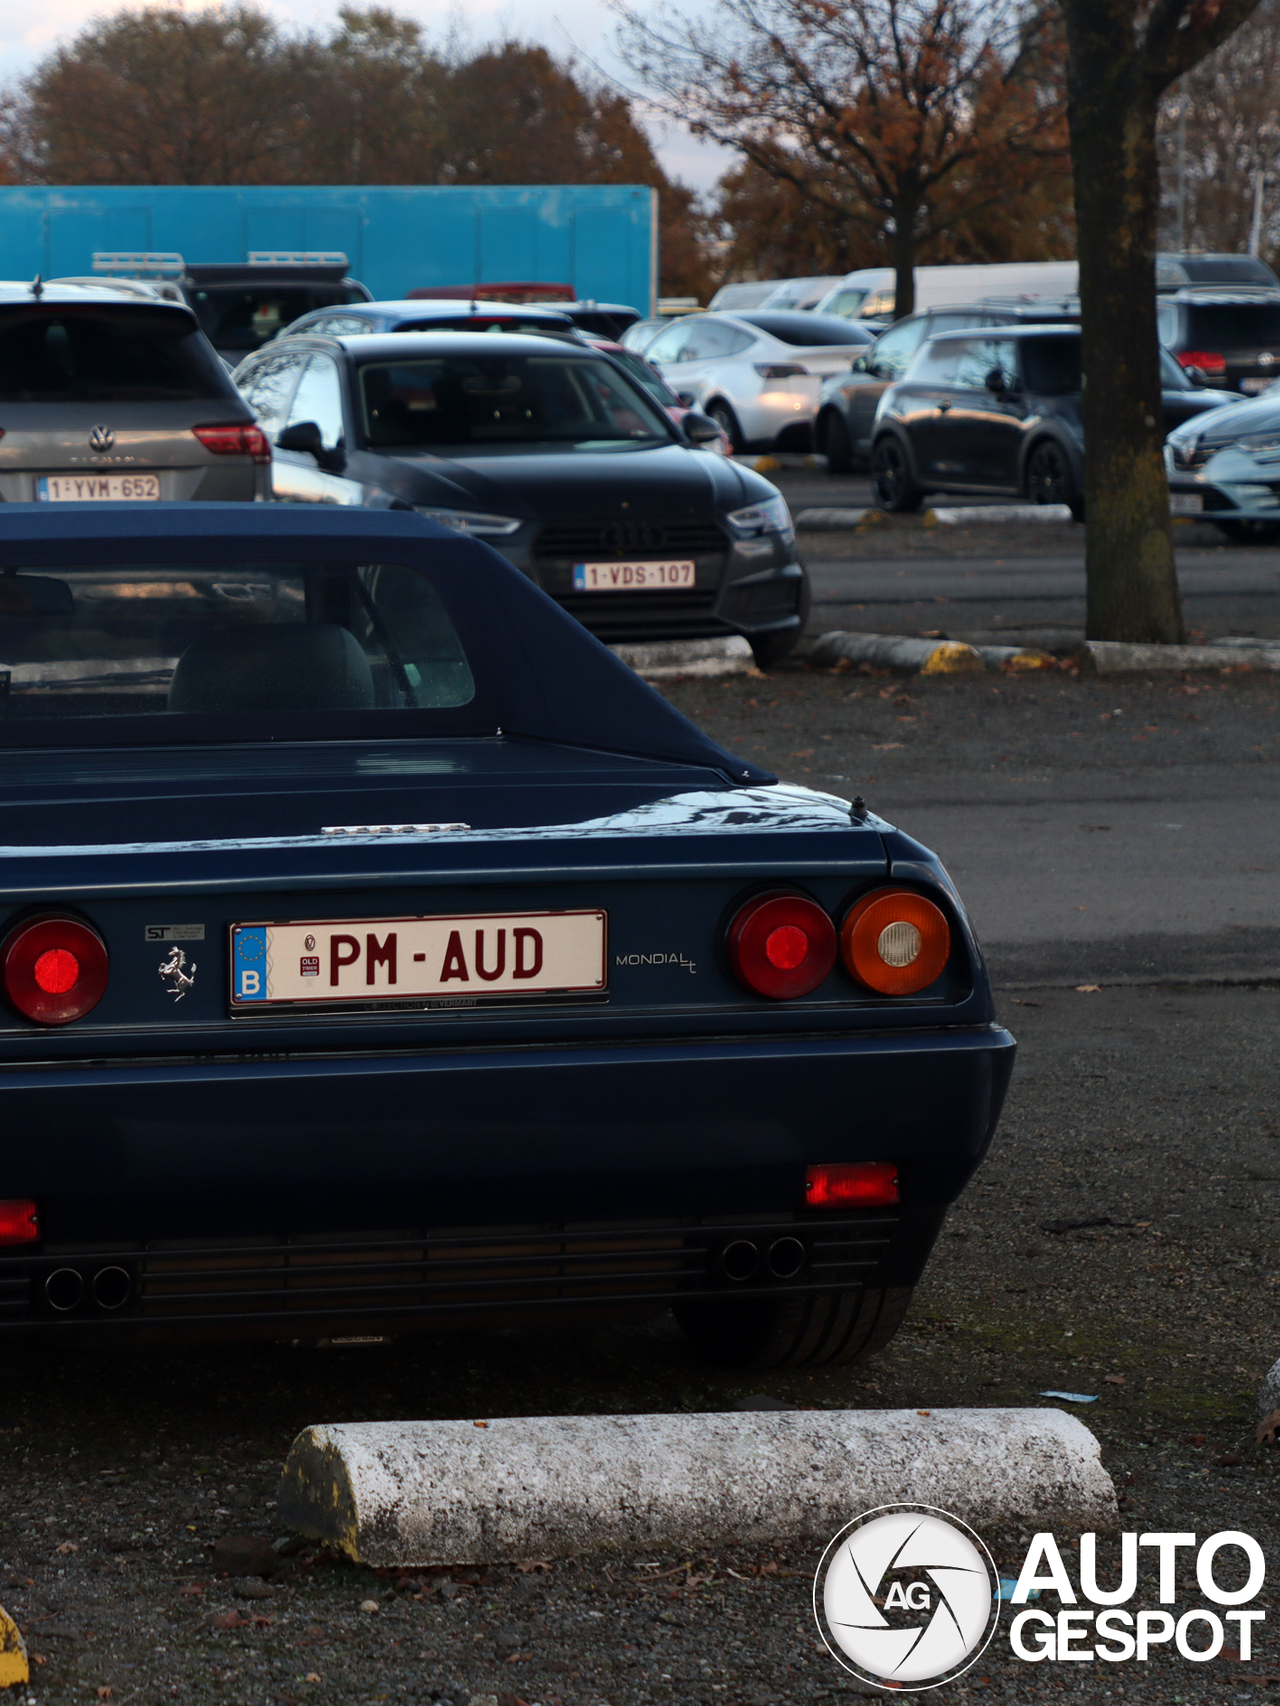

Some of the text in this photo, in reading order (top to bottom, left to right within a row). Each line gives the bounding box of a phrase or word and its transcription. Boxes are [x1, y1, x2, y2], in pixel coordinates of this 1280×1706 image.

[590, 565, 691, 584] 1-VDS-107
[301, 957, 318, 966] OLD
[616, 953, 688, 966] MONDIAL
[241, 970, 261, 995] B
[439, 998, 478, 1008] VERMANT
